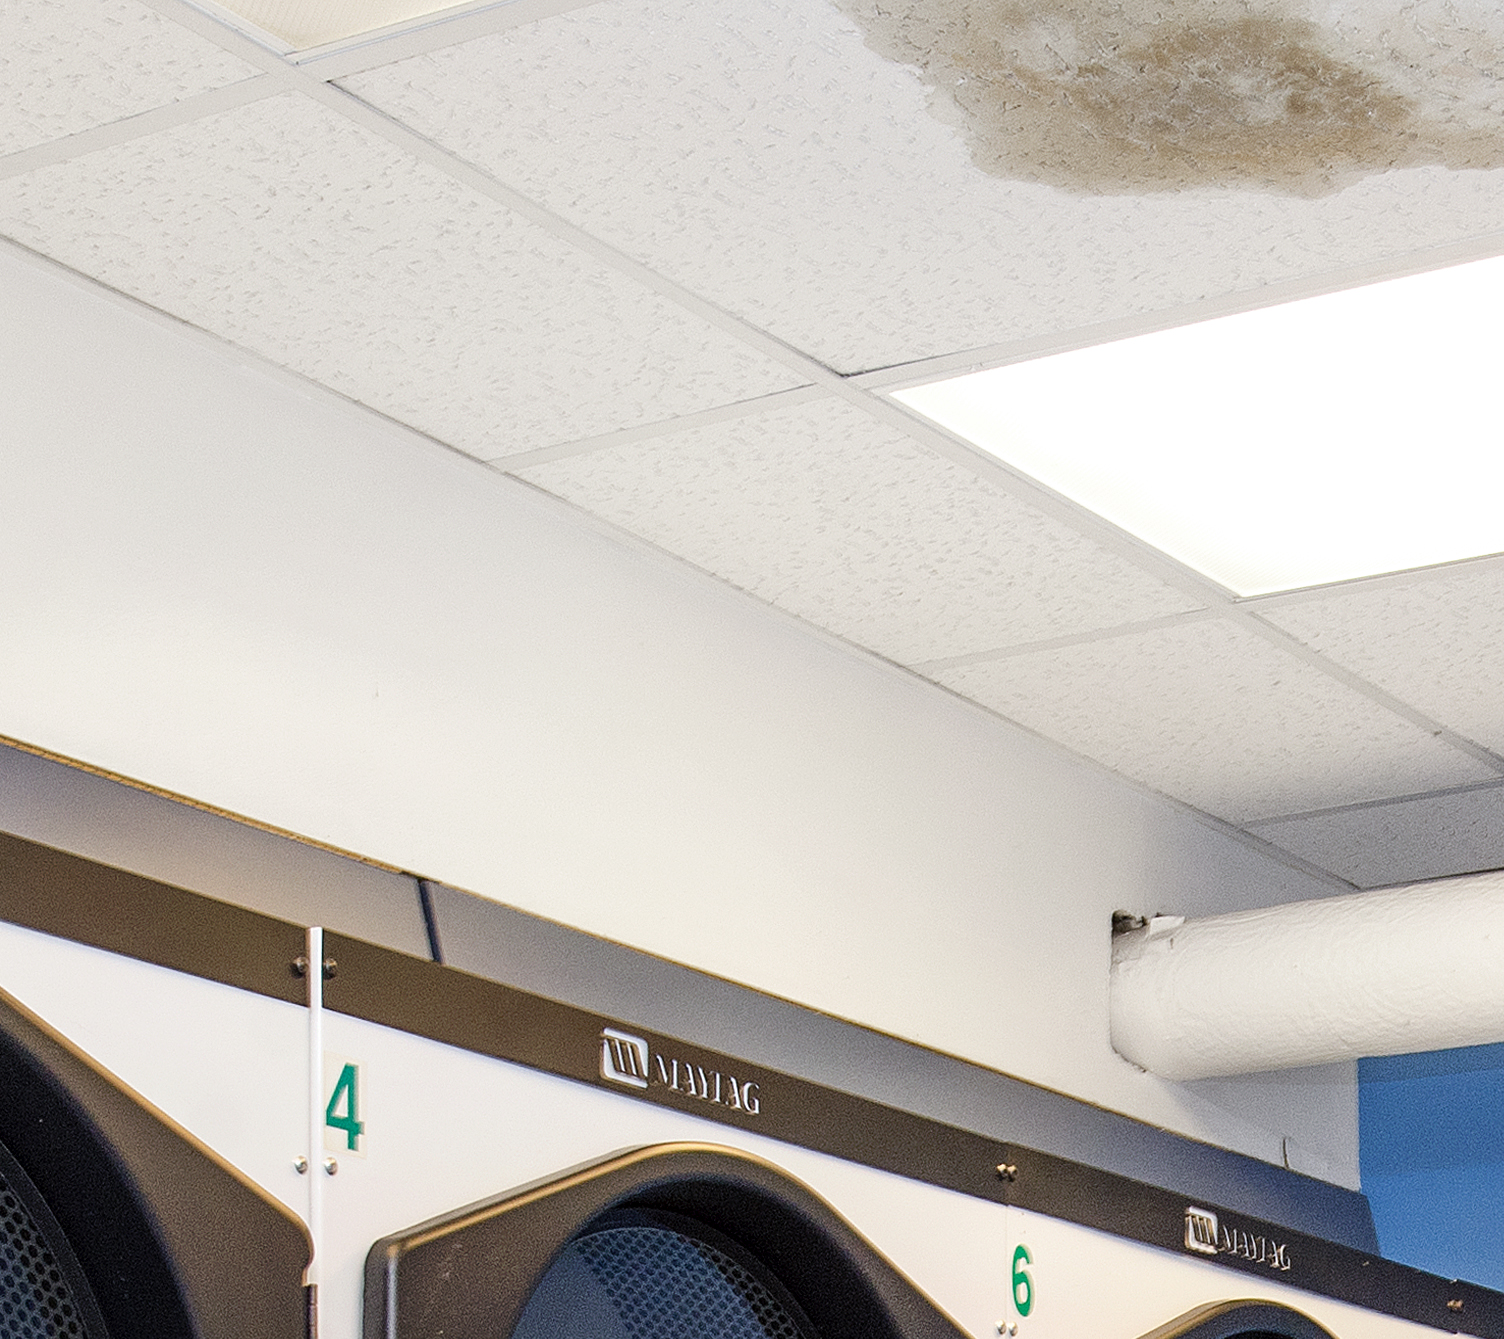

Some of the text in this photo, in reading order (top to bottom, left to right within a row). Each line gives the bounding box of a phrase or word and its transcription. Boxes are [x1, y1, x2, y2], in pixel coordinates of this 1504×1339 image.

[326, 1065, 361, 1149] 4
[651, 1054, 760, 1115] MAYTAG
[1012, 1246, 1032, 1317] 6
